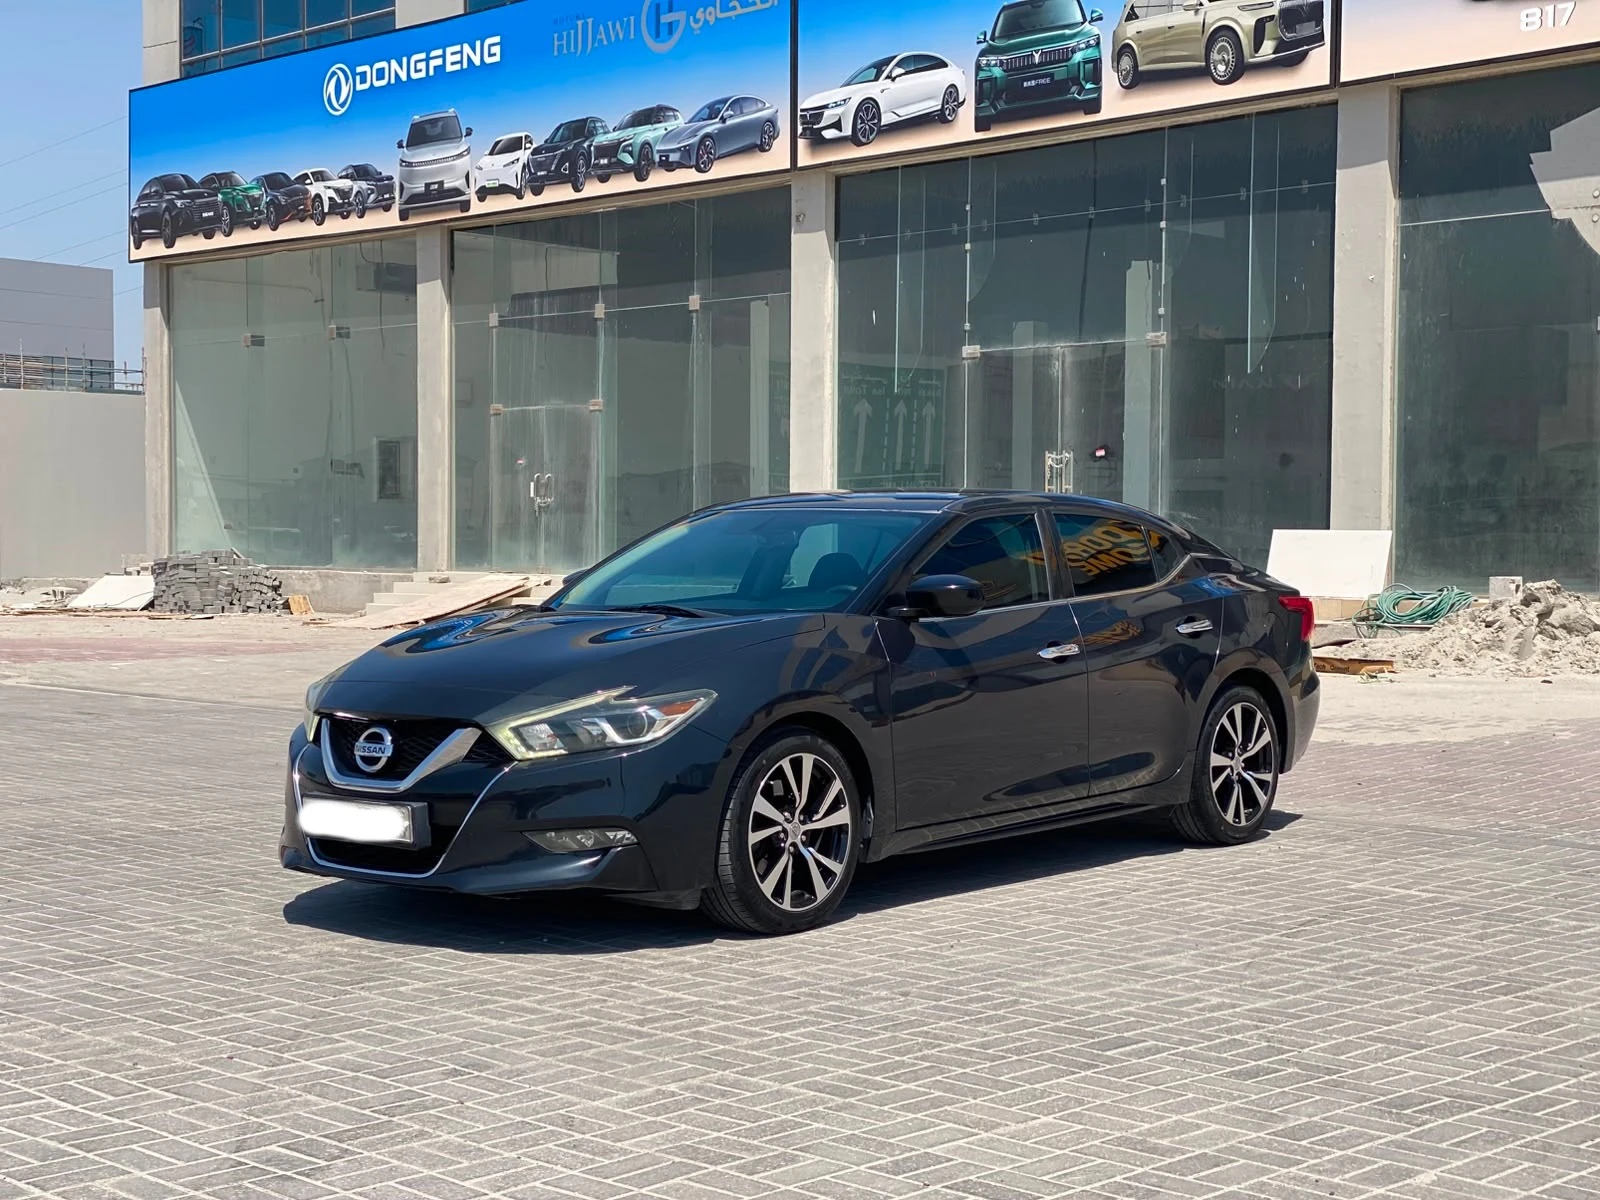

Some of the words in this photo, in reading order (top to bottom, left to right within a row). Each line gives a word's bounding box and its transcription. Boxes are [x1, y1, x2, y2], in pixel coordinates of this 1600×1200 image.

[689, 0, 778, 35] حجاوي
[1520, 1, 1577, 31] 817
[553, 16, 635, 57] HIJJAWI
[355, 35, 502, 91] DONGFENG
[355, 744, 386, 755] NISSAN
